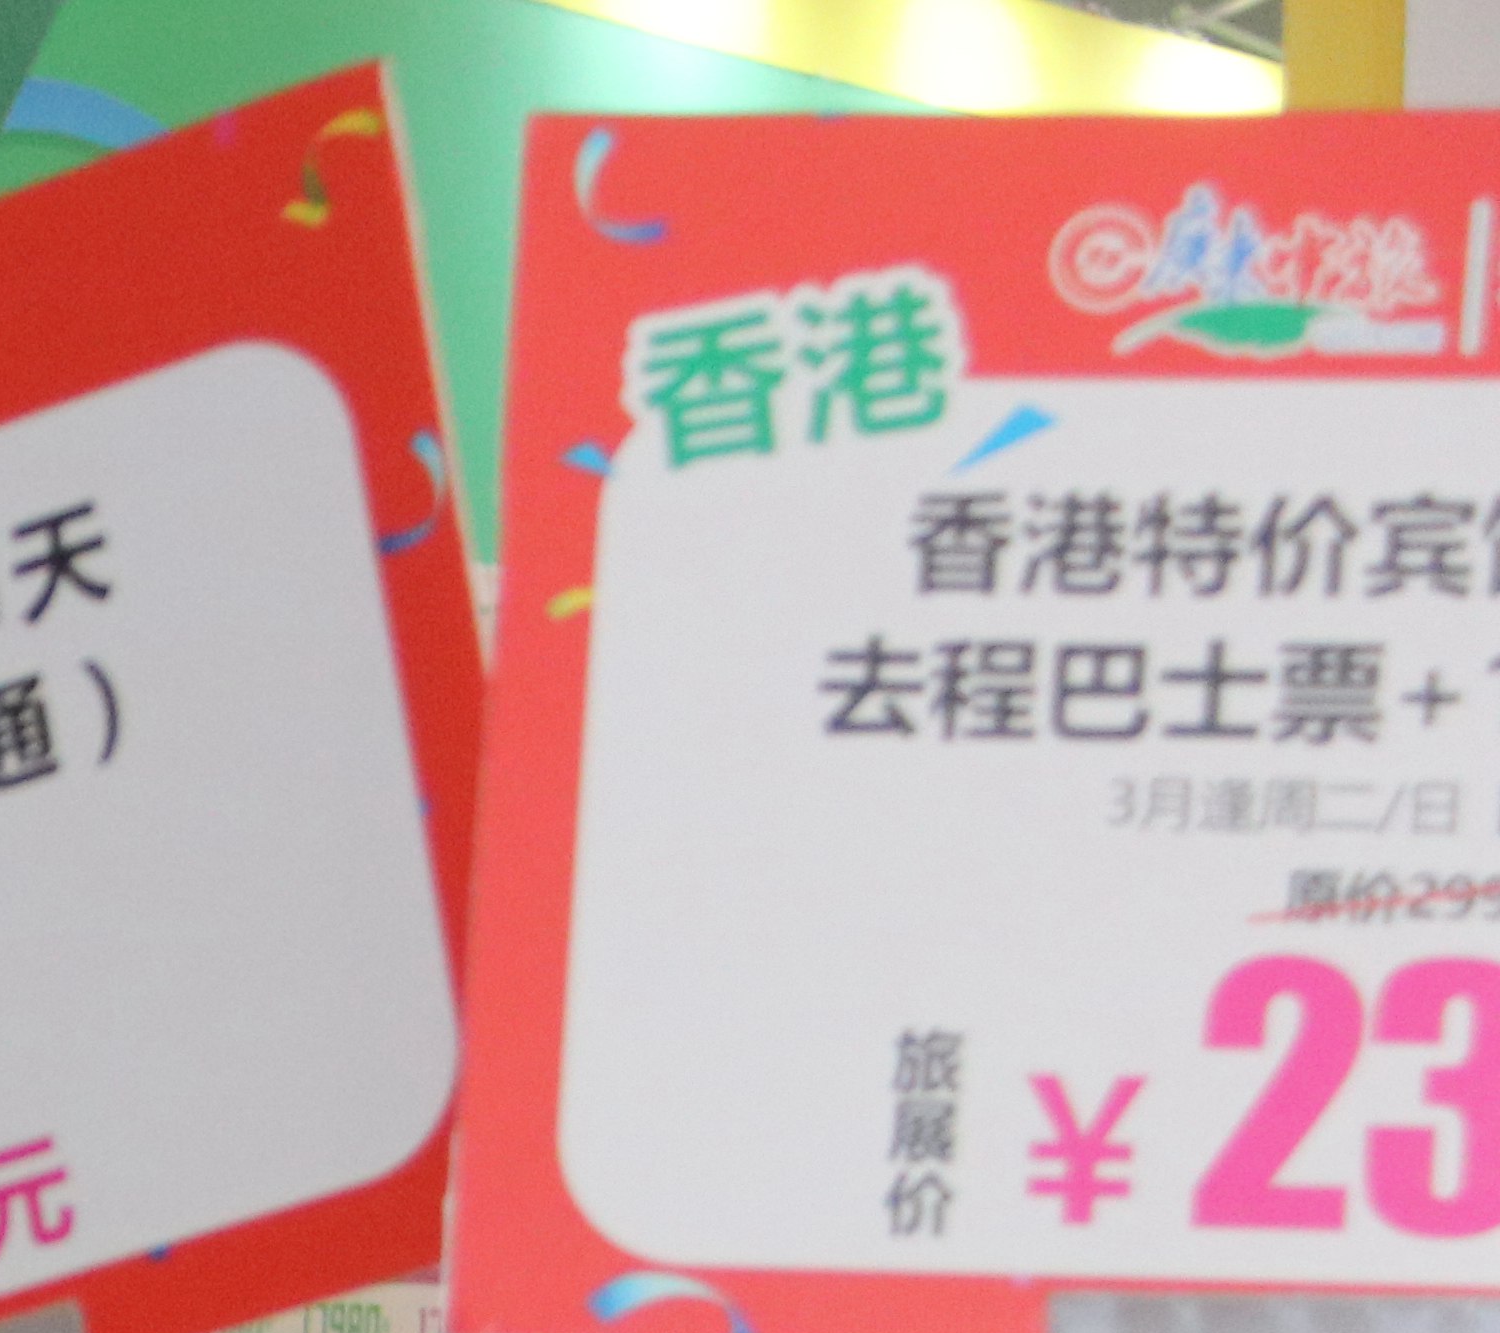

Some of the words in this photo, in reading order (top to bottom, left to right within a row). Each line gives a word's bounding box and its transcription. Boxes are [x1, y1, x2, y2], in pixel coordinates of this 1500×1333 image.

[642, 284, 948, 468] 香港
[819, 633, 1500, 746] 去程巴士票+
[886, 1029, 964, 1239] 旅展价
